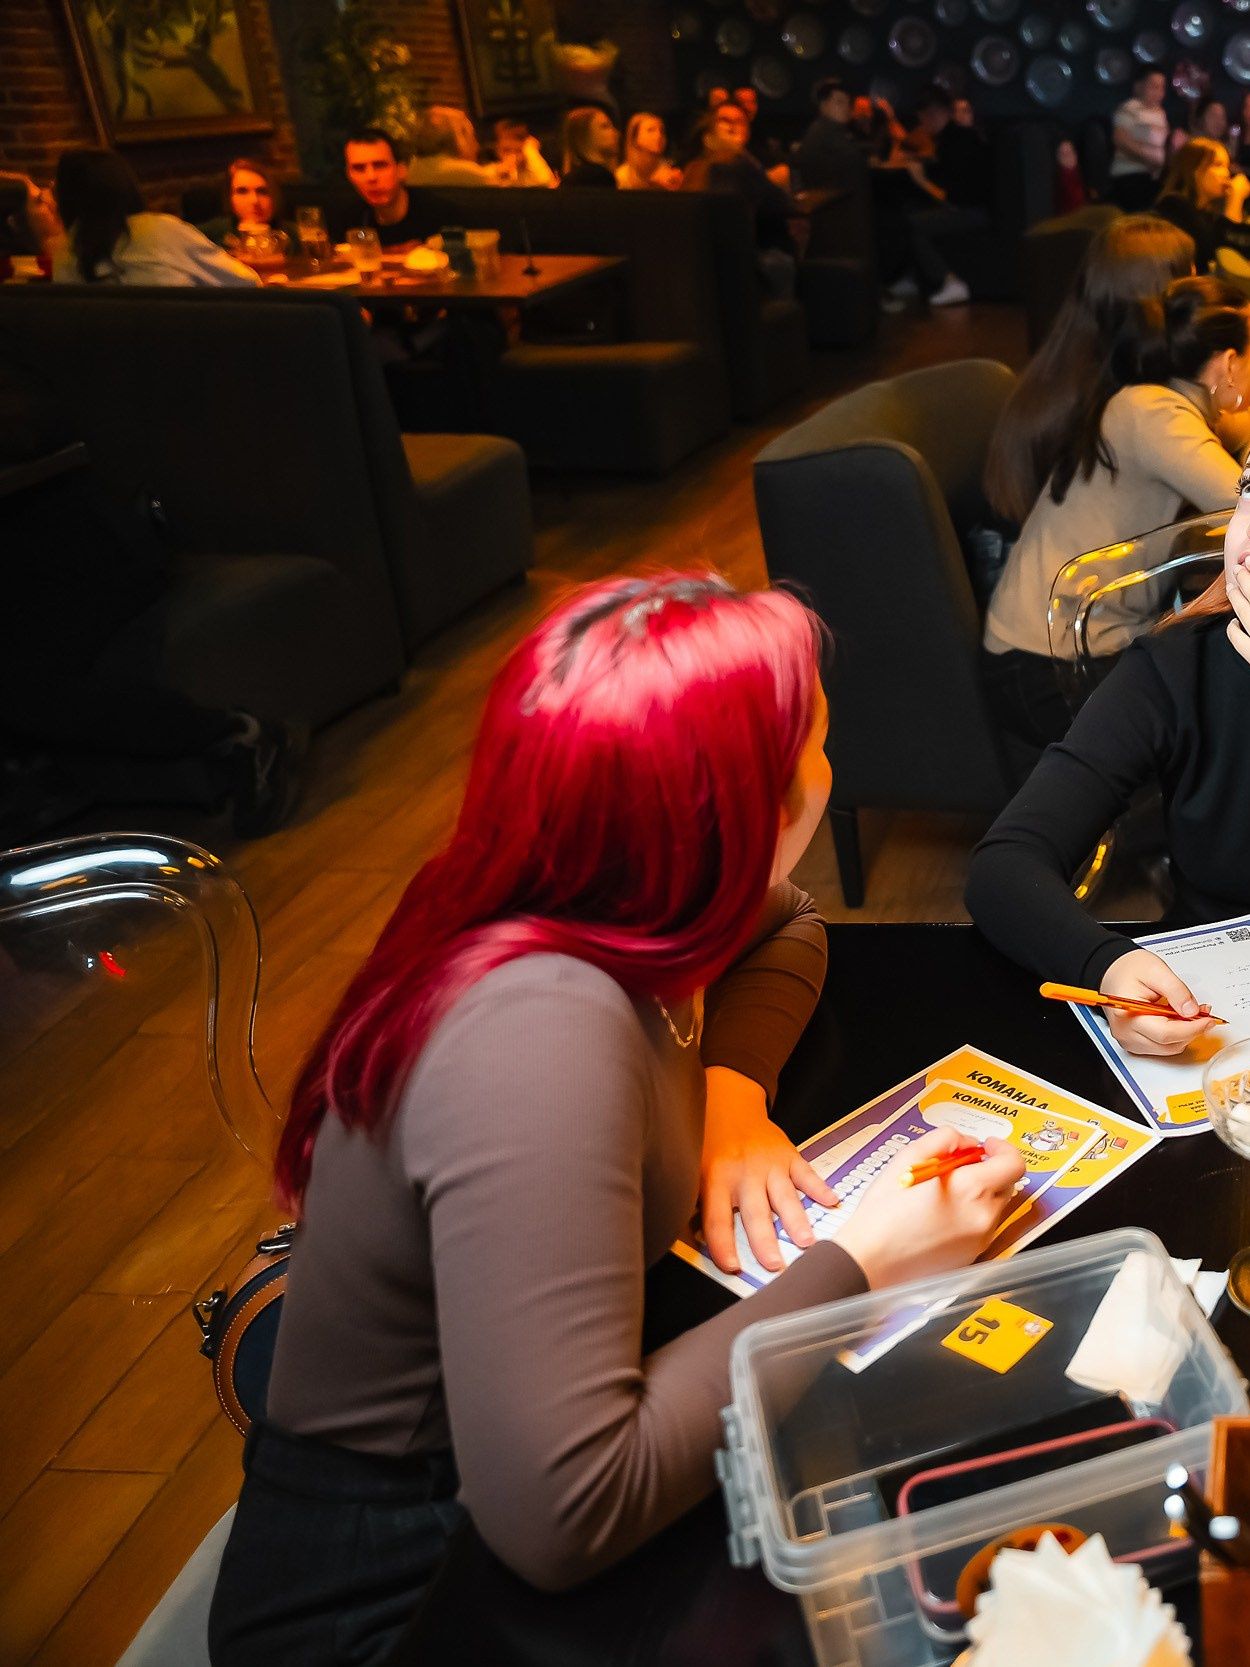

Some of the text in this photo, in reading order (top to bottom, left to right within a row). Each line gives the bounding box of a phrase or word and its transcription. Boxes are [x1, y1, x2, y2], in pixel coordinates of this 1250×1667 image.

[966, 1070, 1049, 1110] КОМАНДА
[952, 1092, 1019, 1118] КОМАНДА
[958, 1317, 1000, 1345] 15
